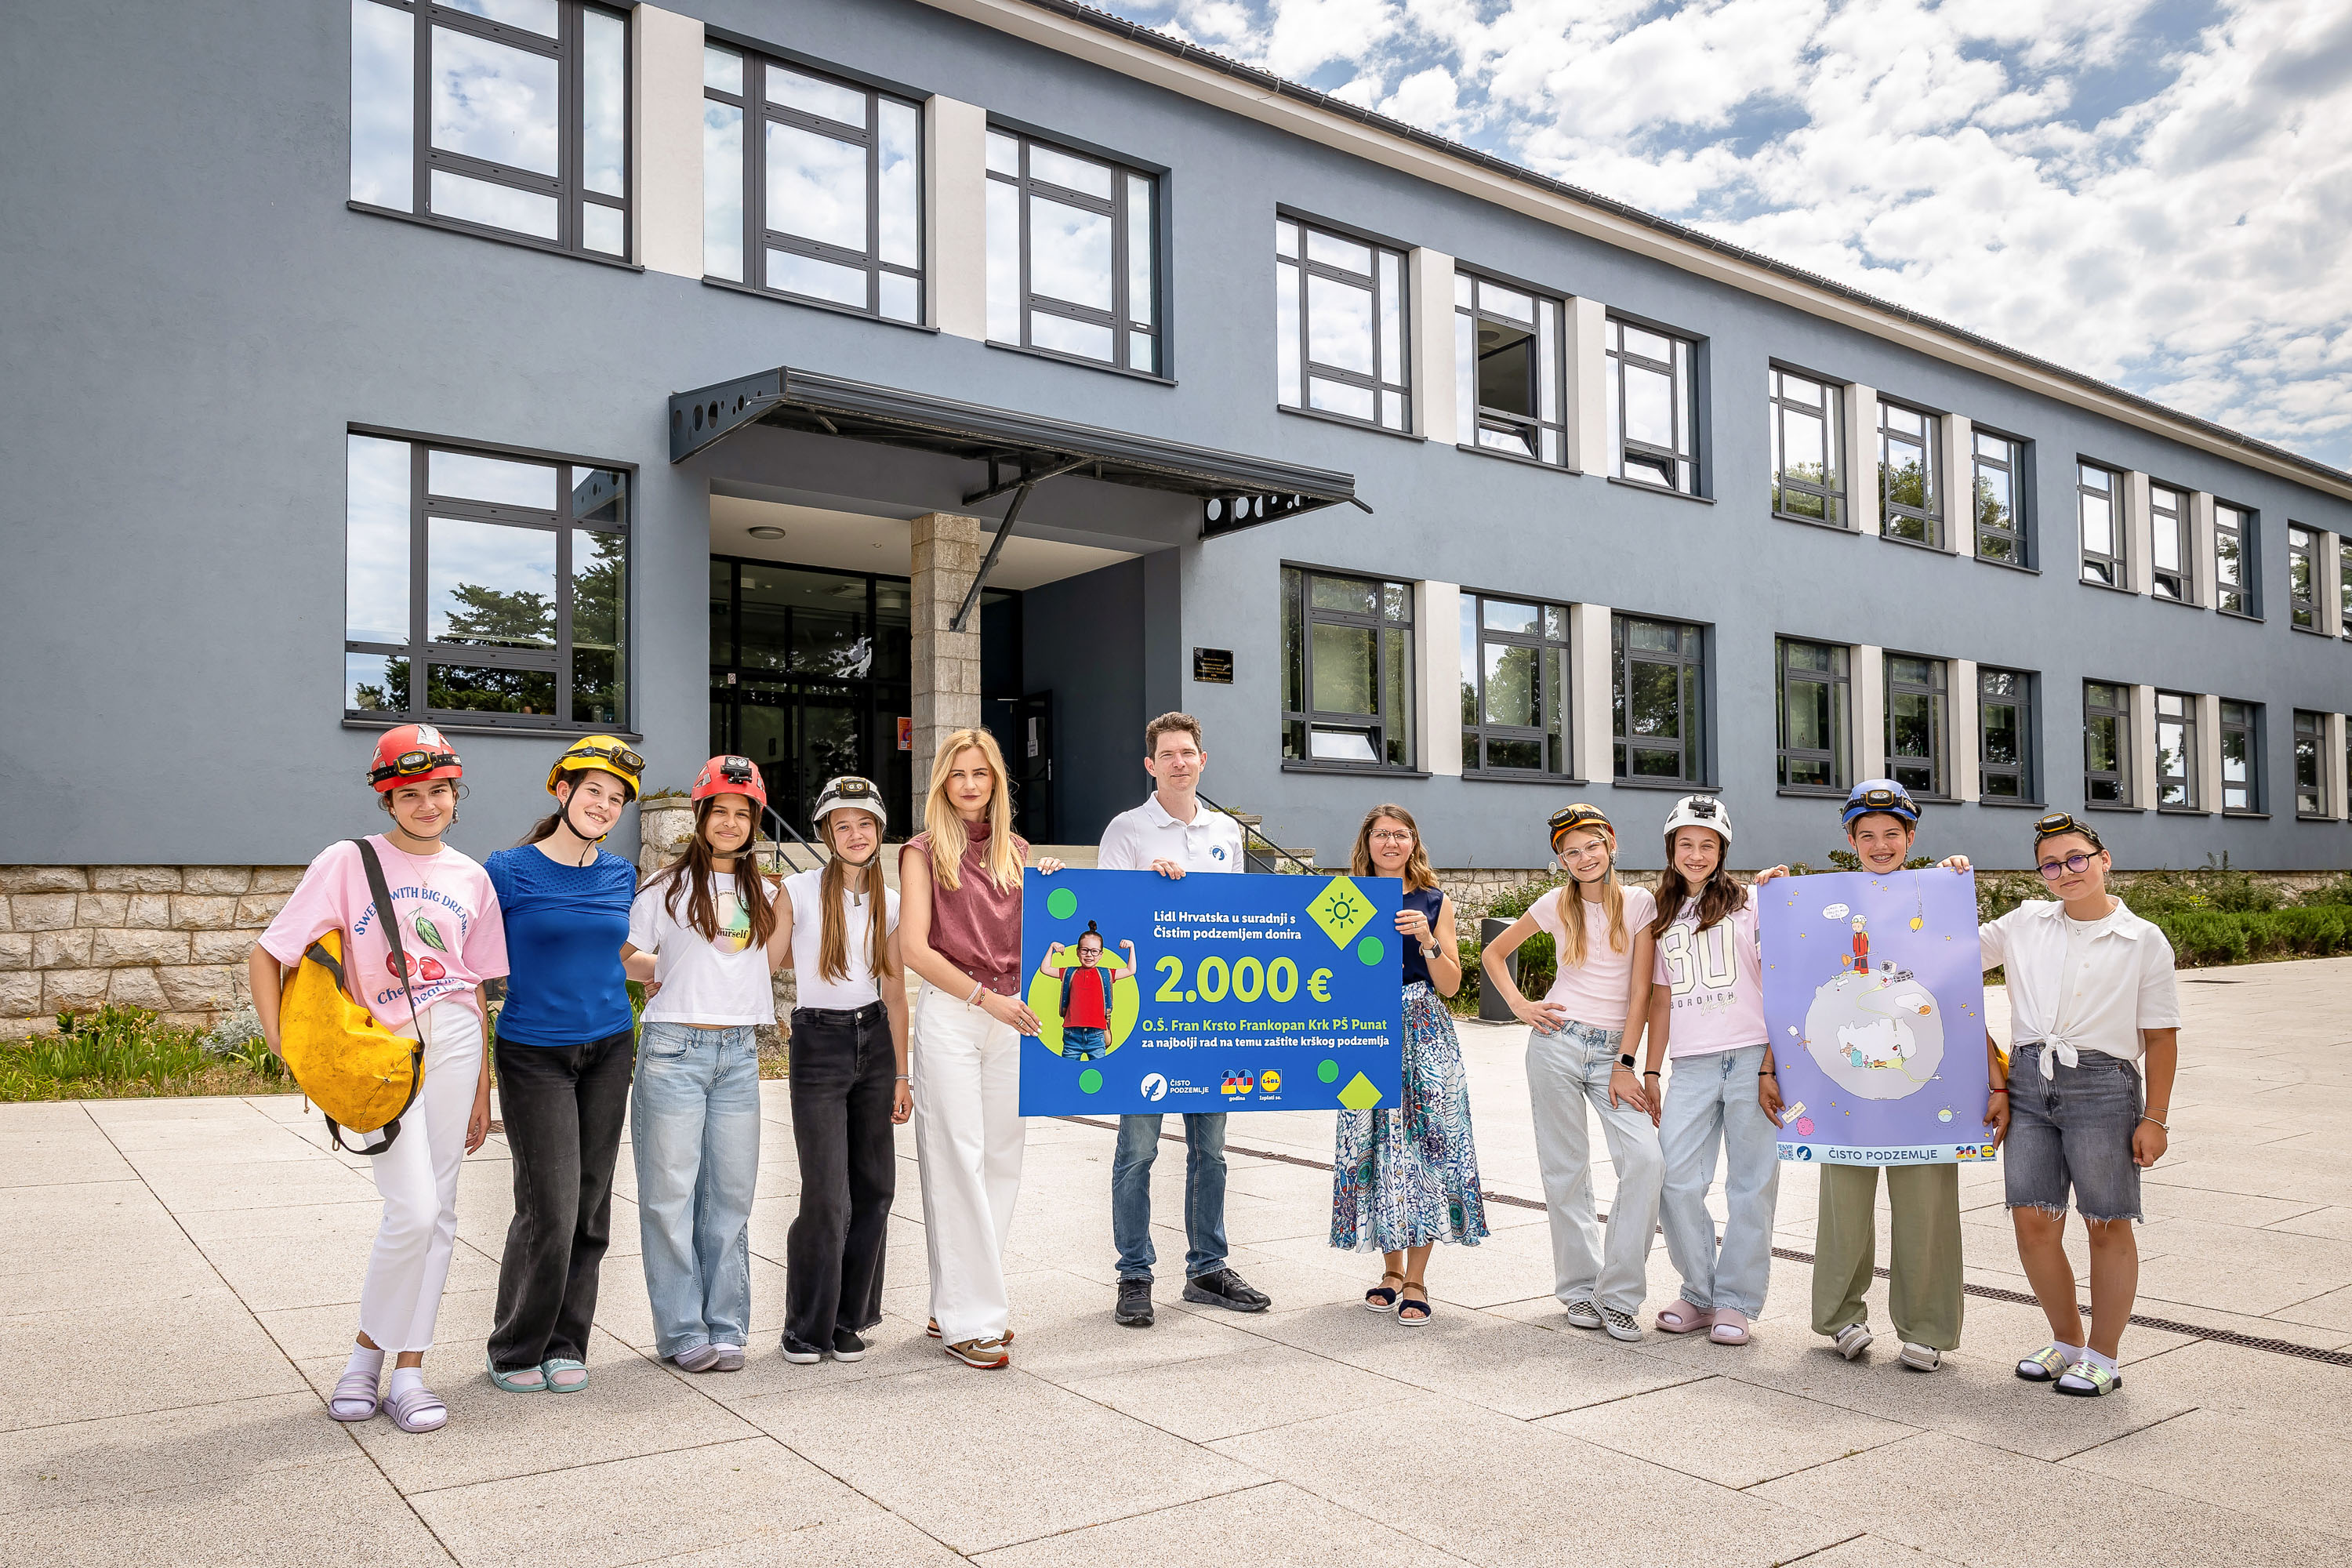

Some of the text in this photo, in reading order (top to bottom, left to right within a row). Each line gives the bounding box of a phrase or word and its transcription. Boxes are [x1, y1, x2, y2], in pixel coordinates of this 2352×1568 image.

[353, 901, 378, 935] SWE
[389, 886, 419, 901] WITH
[421, 888, 441, 902] BIG
[1154, 910, 1296, 927] Lidl Hrvatska u suradnji s
[1153, 924, 1302, 942] Čistim podzemljem donira
[1155, 955, 1334, 1003] 2.000 €
[1142, 1016, 1387, 1033] O.Š. Fran Krsto Frankopan Krk PŠ Punat
[1142, 1035, 1390, 1050] za najbolji rad na temu zaštite krškog podzemlja
[1221, 1069, 1254, 1094] 20
[1828, 1147, 1938, 1160] ČISTO PODZEMLJE
[1955, 1145, 1977, 1159] 20
